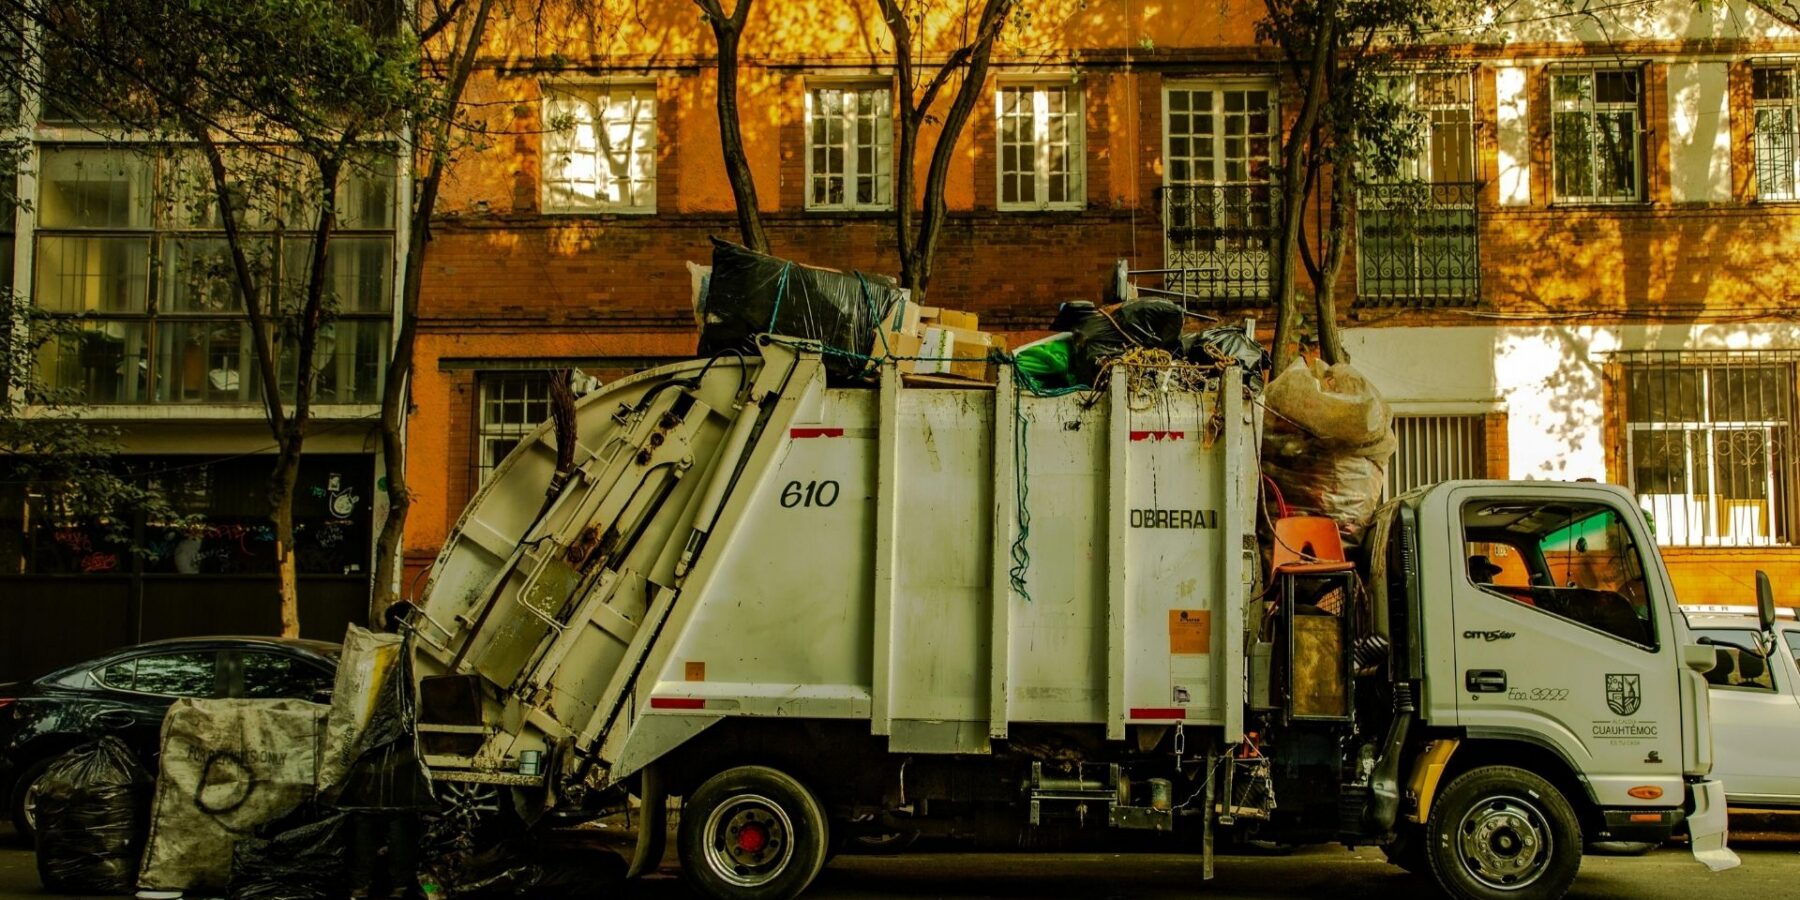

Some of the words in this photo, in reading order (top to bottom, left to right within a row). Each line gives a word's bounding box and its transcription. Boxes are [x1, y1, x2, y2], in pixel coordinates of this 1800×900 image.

[780, 480, 840, 508] 610
[1130, 509, 1206, 529] OBRERA
[1529, 687, 1570, 701] 3222
[1592, 724, 1658, 736] CUAUHTÉMOC
[259, 751, 287, 766] ONLY
